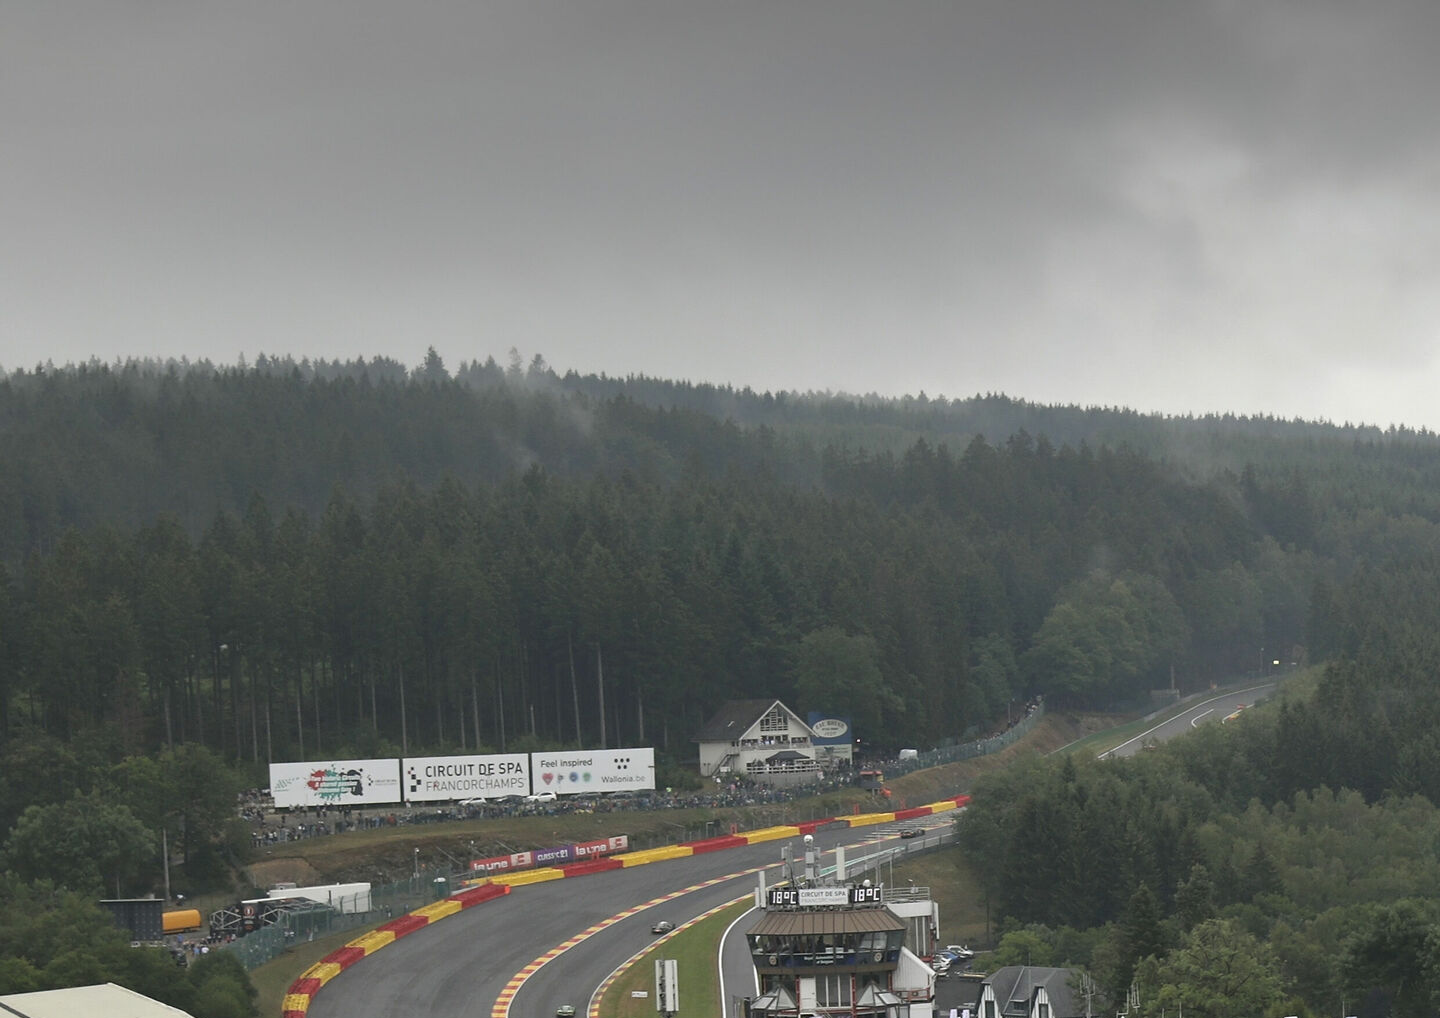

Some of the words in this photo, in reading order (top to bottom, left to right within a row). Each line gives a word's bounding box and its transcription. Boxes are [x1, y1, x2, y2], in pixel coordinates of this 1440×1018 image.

[425, 764, 474, 777] CIRCUIT
[478, 763, 495, 776] DE
[498, 762, 523, 774] SPA
[541, 760, 558, 768] Feel
[560, 759, 592, 767] inspired
[426, 777, 525, 791] FRANCORCHAMPS
[601, 775, 646, 783] Wallonia.be
[576, 847, 586, 856] la
[587, 844, 607, 854] une
[474, 863, 485, 871] la
[486, 859, 508, 870] une
[773, 892, 796, 904] 18°C
[854, 888, 880, 902] 18°C
